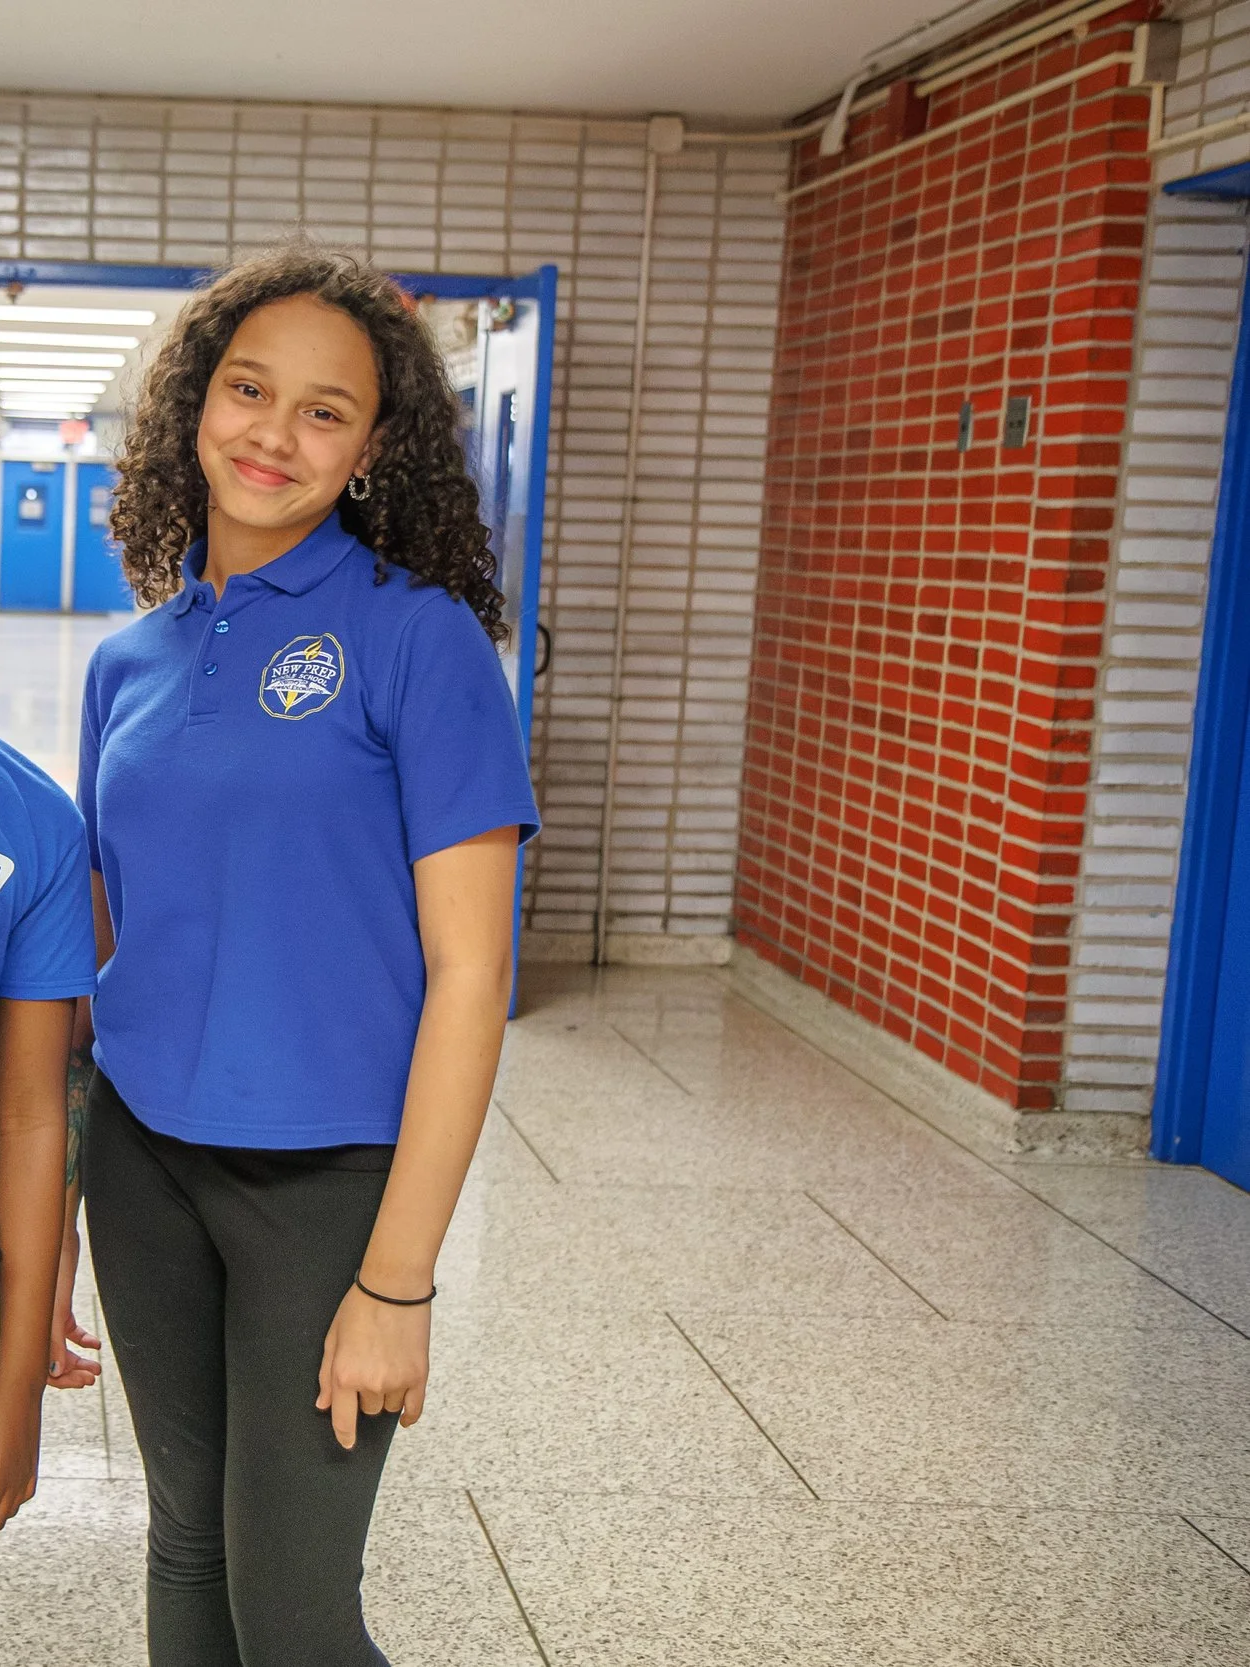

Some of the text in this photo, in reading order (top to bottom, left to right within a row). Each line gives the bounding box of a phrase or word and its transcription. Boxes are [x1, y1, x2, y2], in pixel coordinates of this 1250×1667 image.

[271, 664, 337, 680] NEW PREP
[298, 674, 329, 687] SCHOOL
